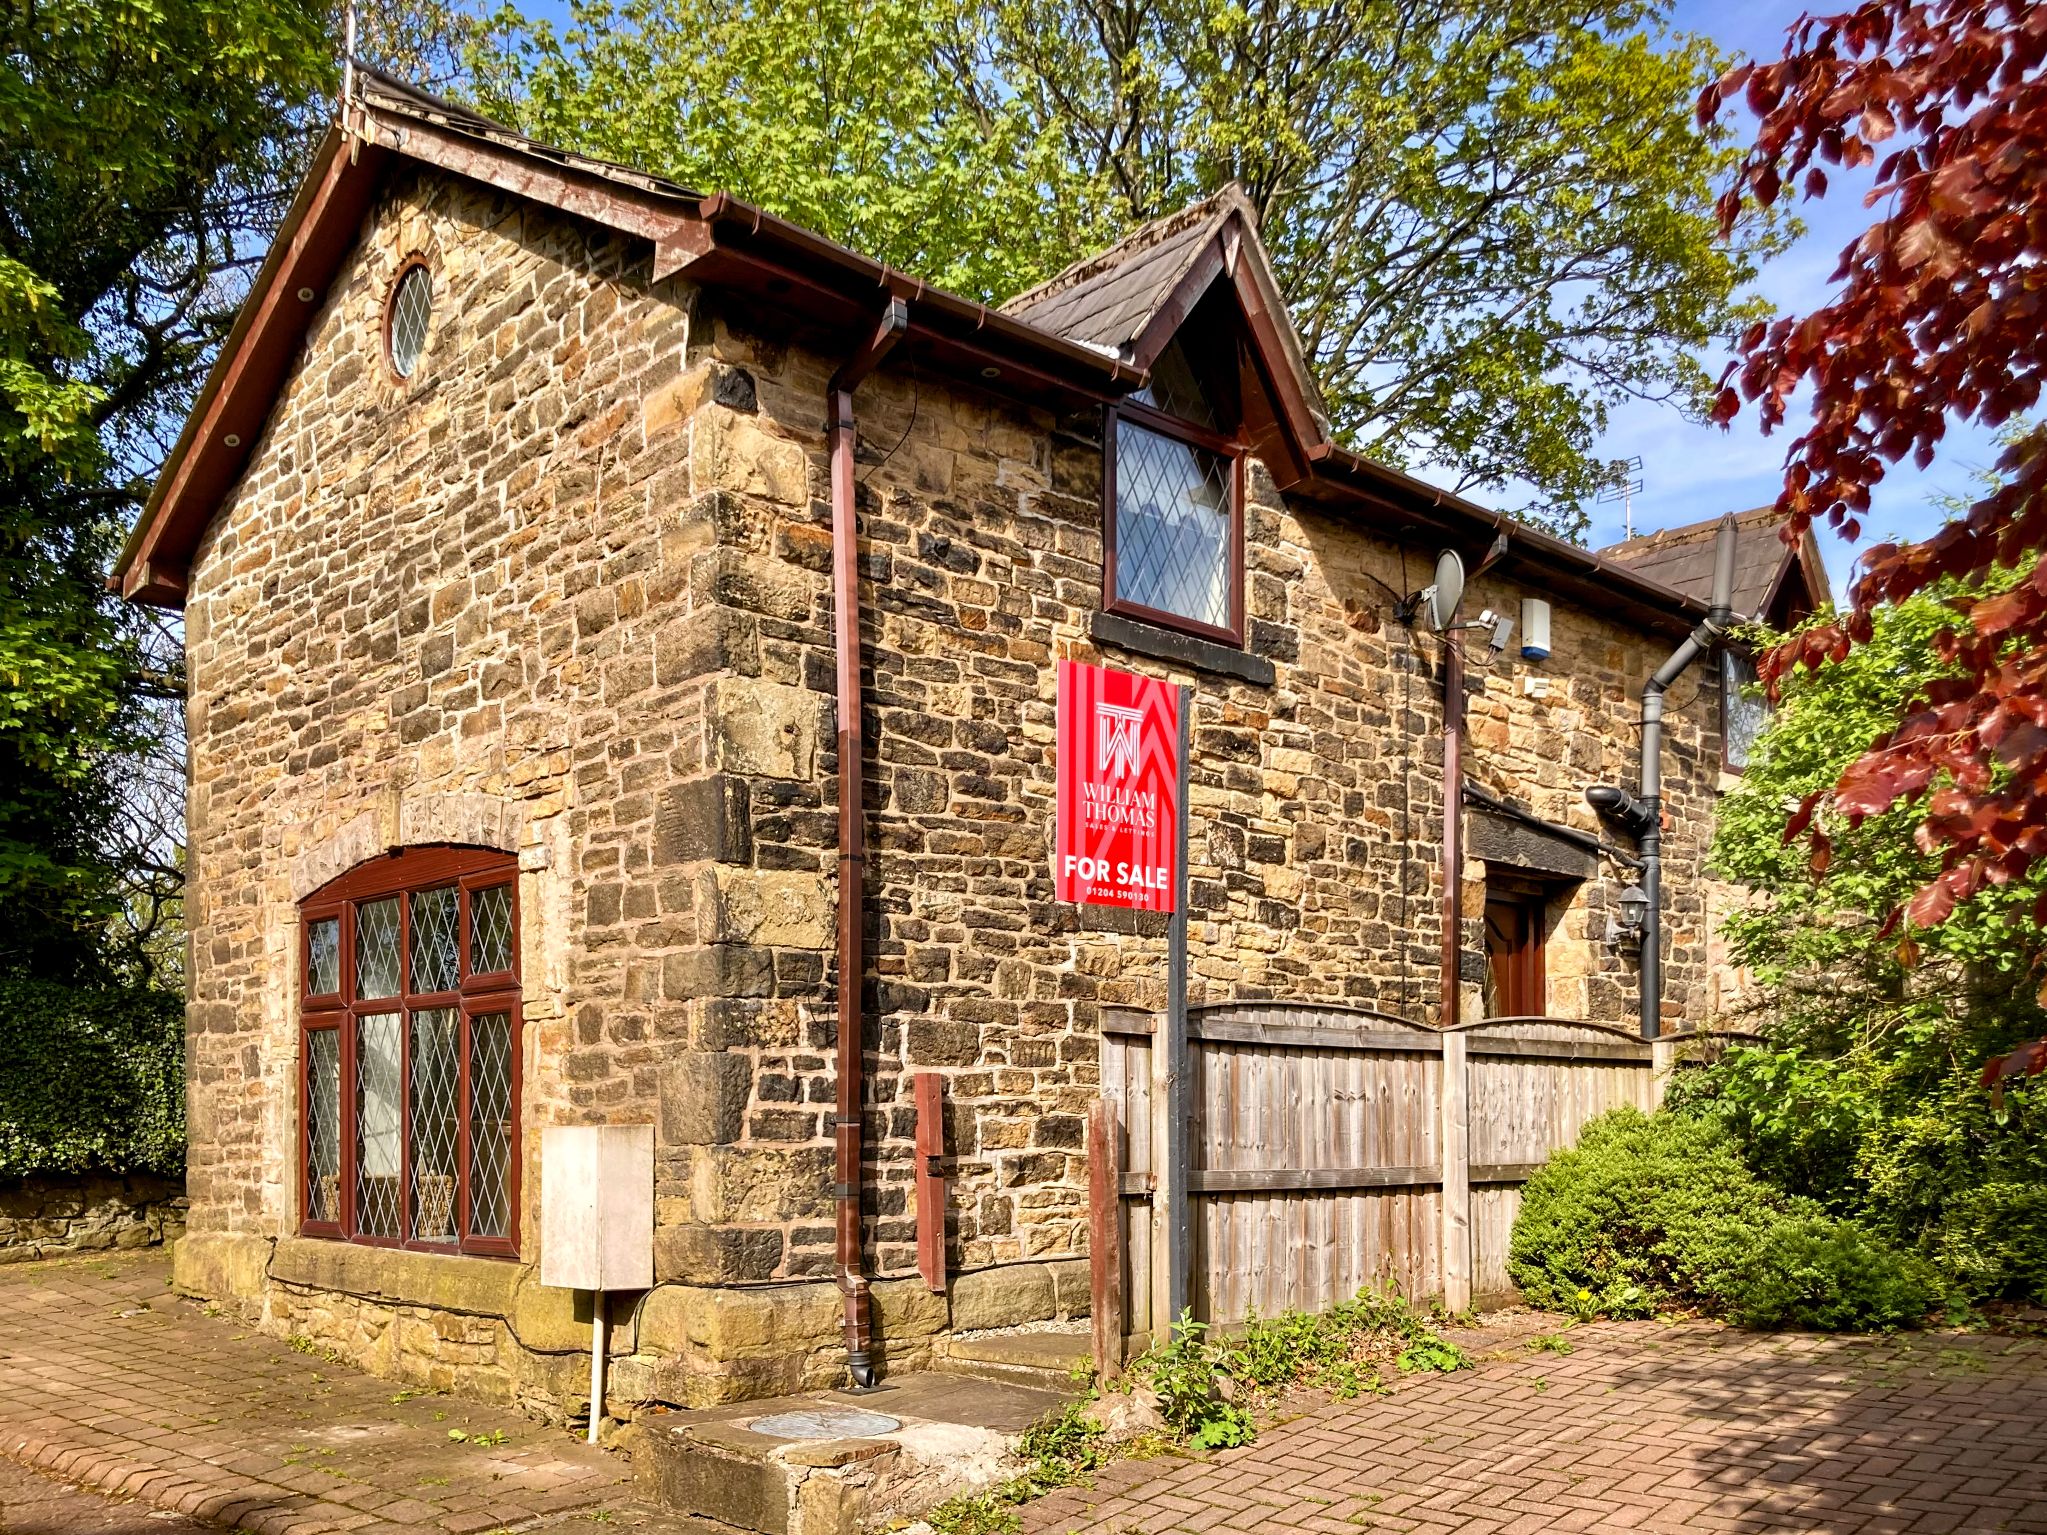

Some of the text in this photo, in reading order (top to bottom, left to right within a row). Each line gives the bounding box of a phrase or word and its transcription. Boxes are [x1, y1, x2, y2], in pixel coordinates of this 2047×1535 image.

[1083, 782, 1155, 810] WILLIAM
[1083, 800, 1155, 828] THOMAS
[1085, 822, 1109, 831] SALES
[1119, 827, 1155, 838] LETTINGS
[1064, 855, 1168, 890] FOR SALE
[1086, 886, 1149, 902] 01204 590130
